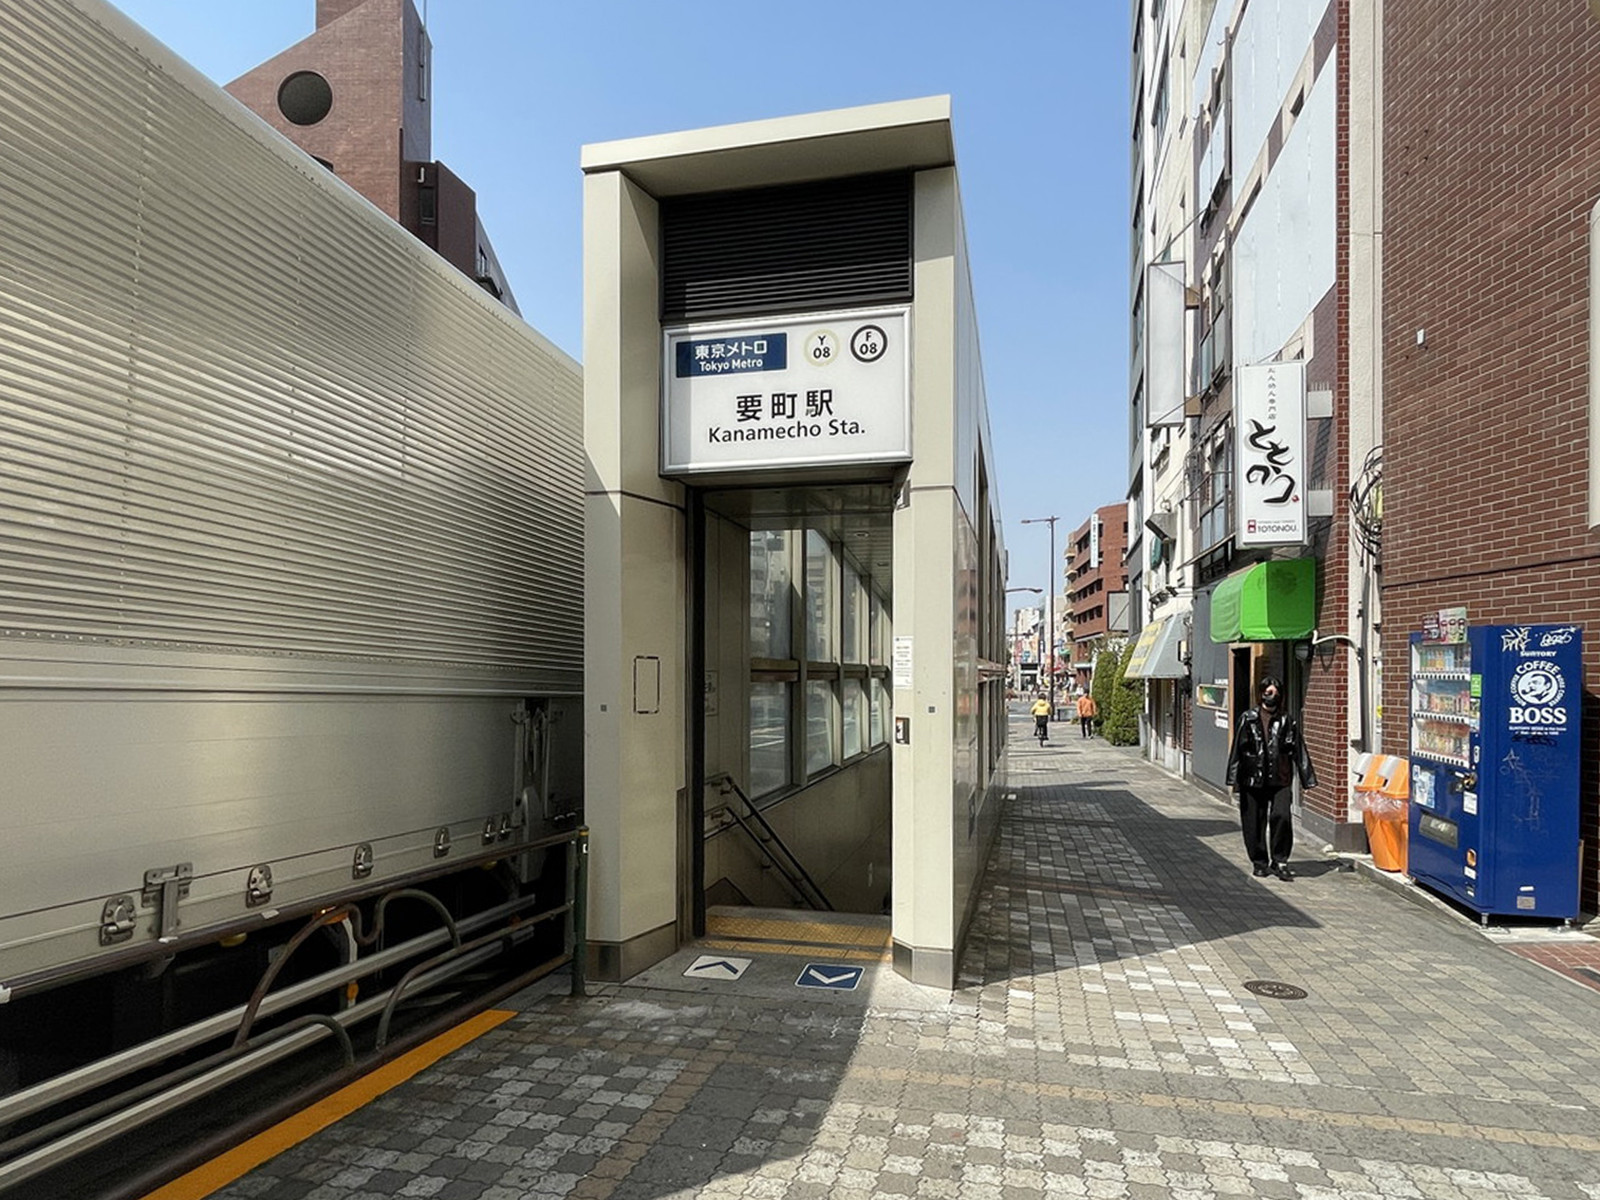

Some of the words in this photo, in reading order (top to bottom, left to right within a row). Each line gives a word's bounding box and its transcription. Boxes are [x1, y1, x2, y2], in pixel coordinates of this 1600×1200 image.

[817, 335, 827, 346] Y
[865, 331, 873, 342] F
[695, 340, 767, 360] 東京メトロ
[812, 346, 831, 359] 08
[859, 343, 878, 355] 08
[700, 361, 730, 373] Tokyo
[731, 358, 763, 370] Metro
[736, 389, 833, 422] 要町駅
[708, 420, 821, 443] Kanamecho
[828, 418, 866, 436] Sta.
[1516, 660, 1561, 675] COFFEE
[1508, 706, 1567, 725] BOSS
